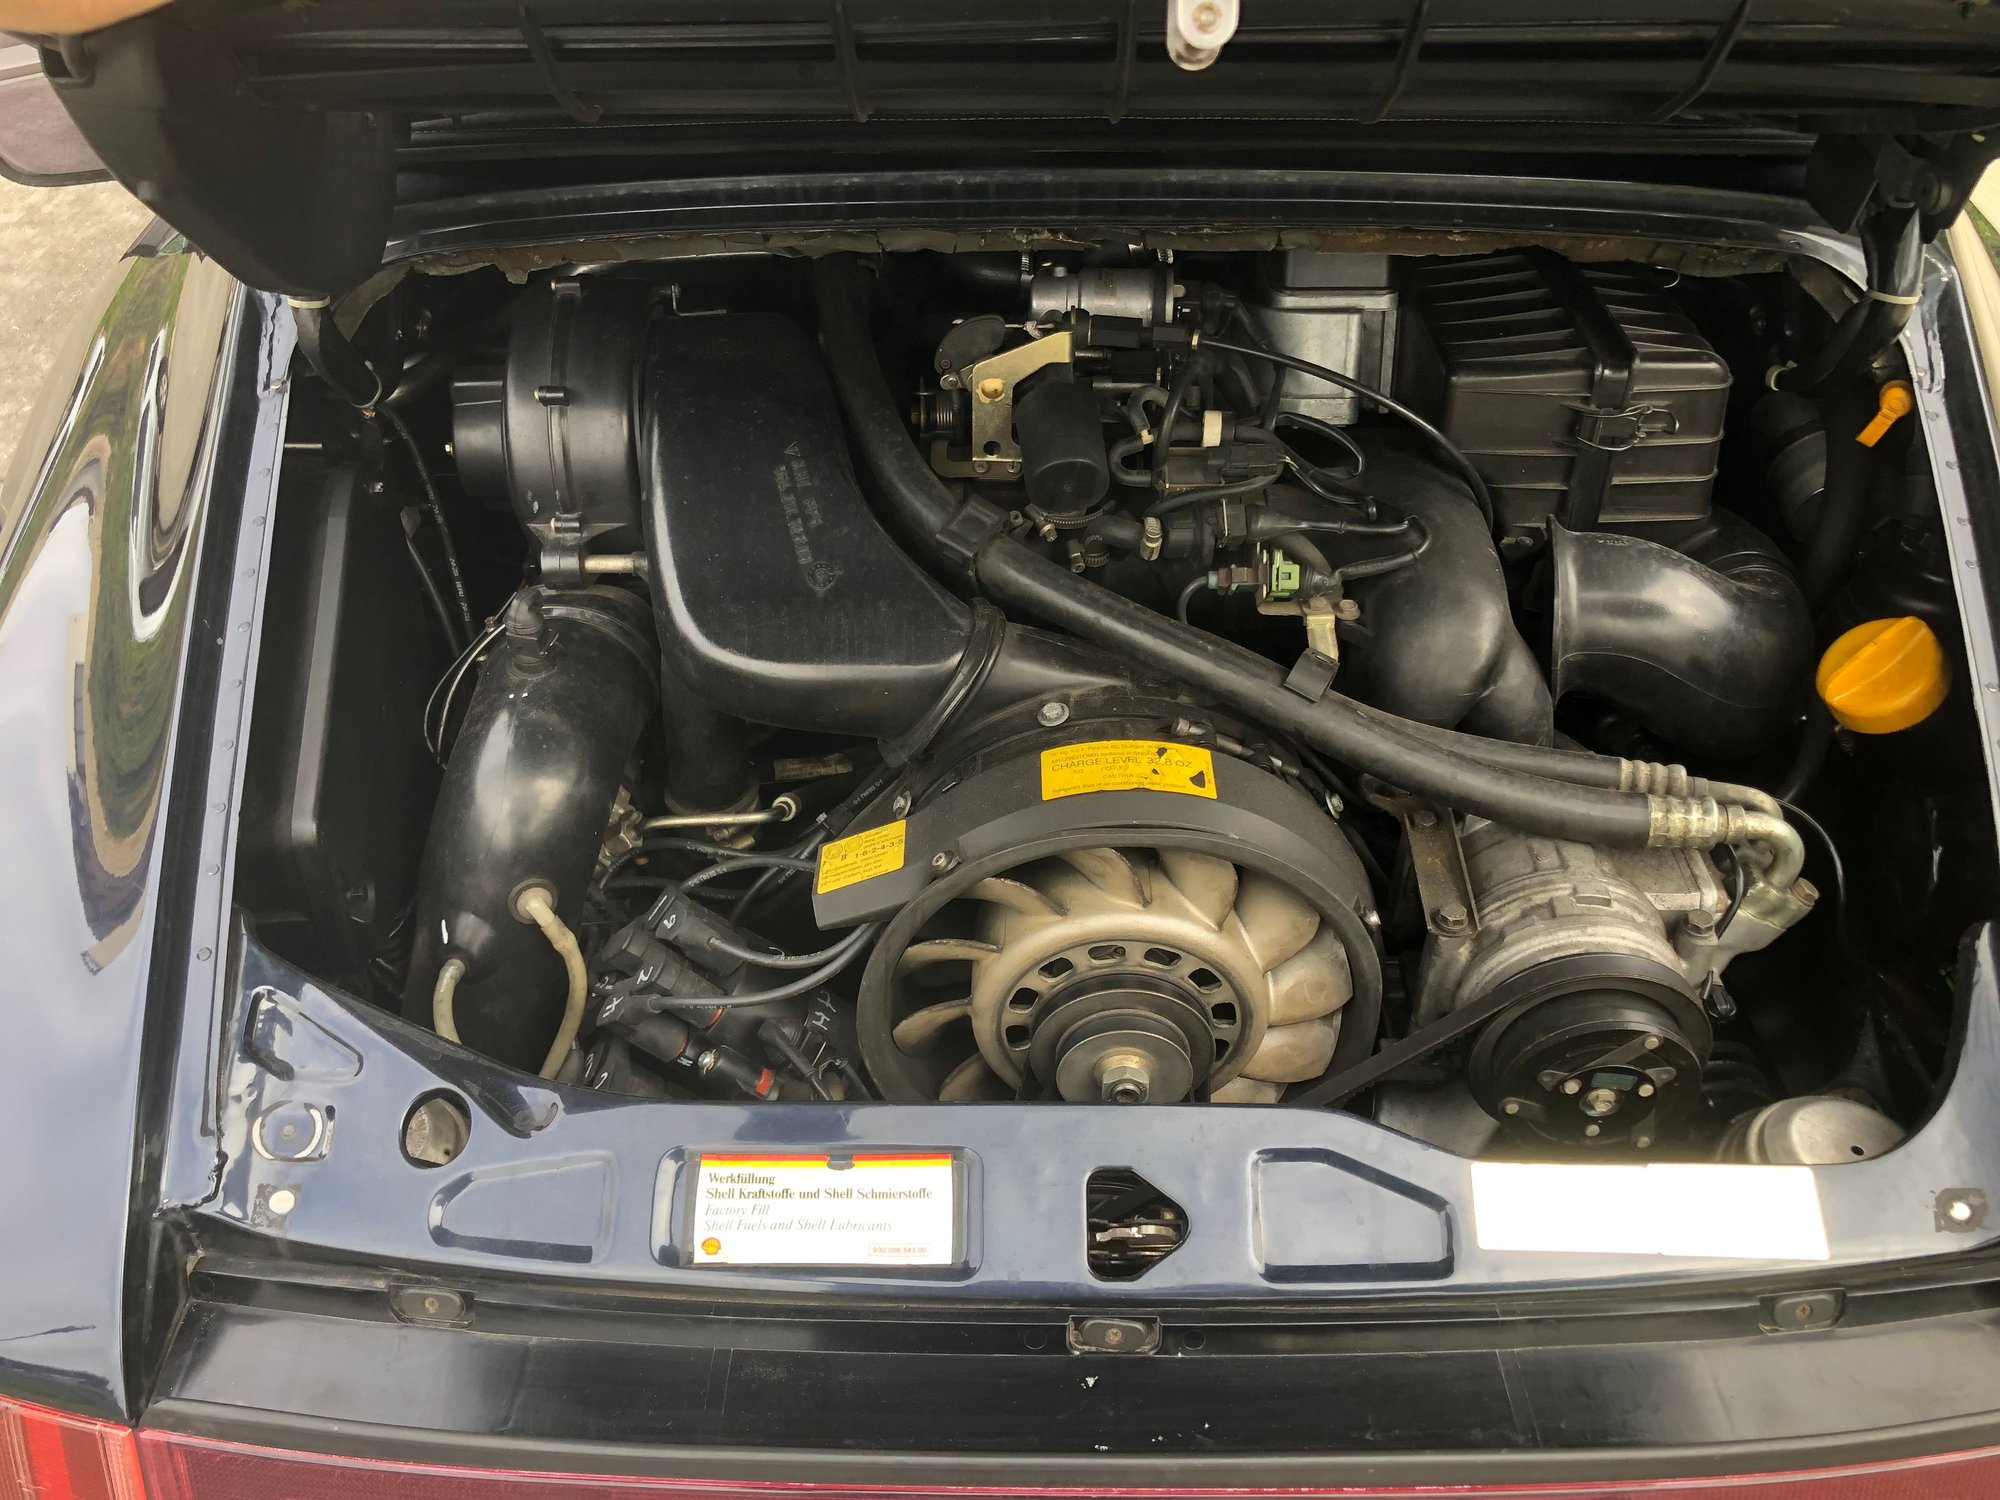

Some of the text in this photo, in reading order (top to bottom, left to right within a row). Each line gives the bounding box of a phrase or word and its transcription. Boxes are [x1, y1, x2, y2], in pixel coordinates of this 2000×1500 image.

[1051, 756, 1193, 772] CHARGE LEVEL 32.8 OZ
[708, 1172, 775, 1185] Werkfüllung
[706, 1188, 933, 1200] Shell Kraftstoffe und Shell Schmierstoffe
[704, 1204, 770, 1217] Factory Fill
[703, 1218, 892, 1232] Shell Fuels and Shell Lubricants
